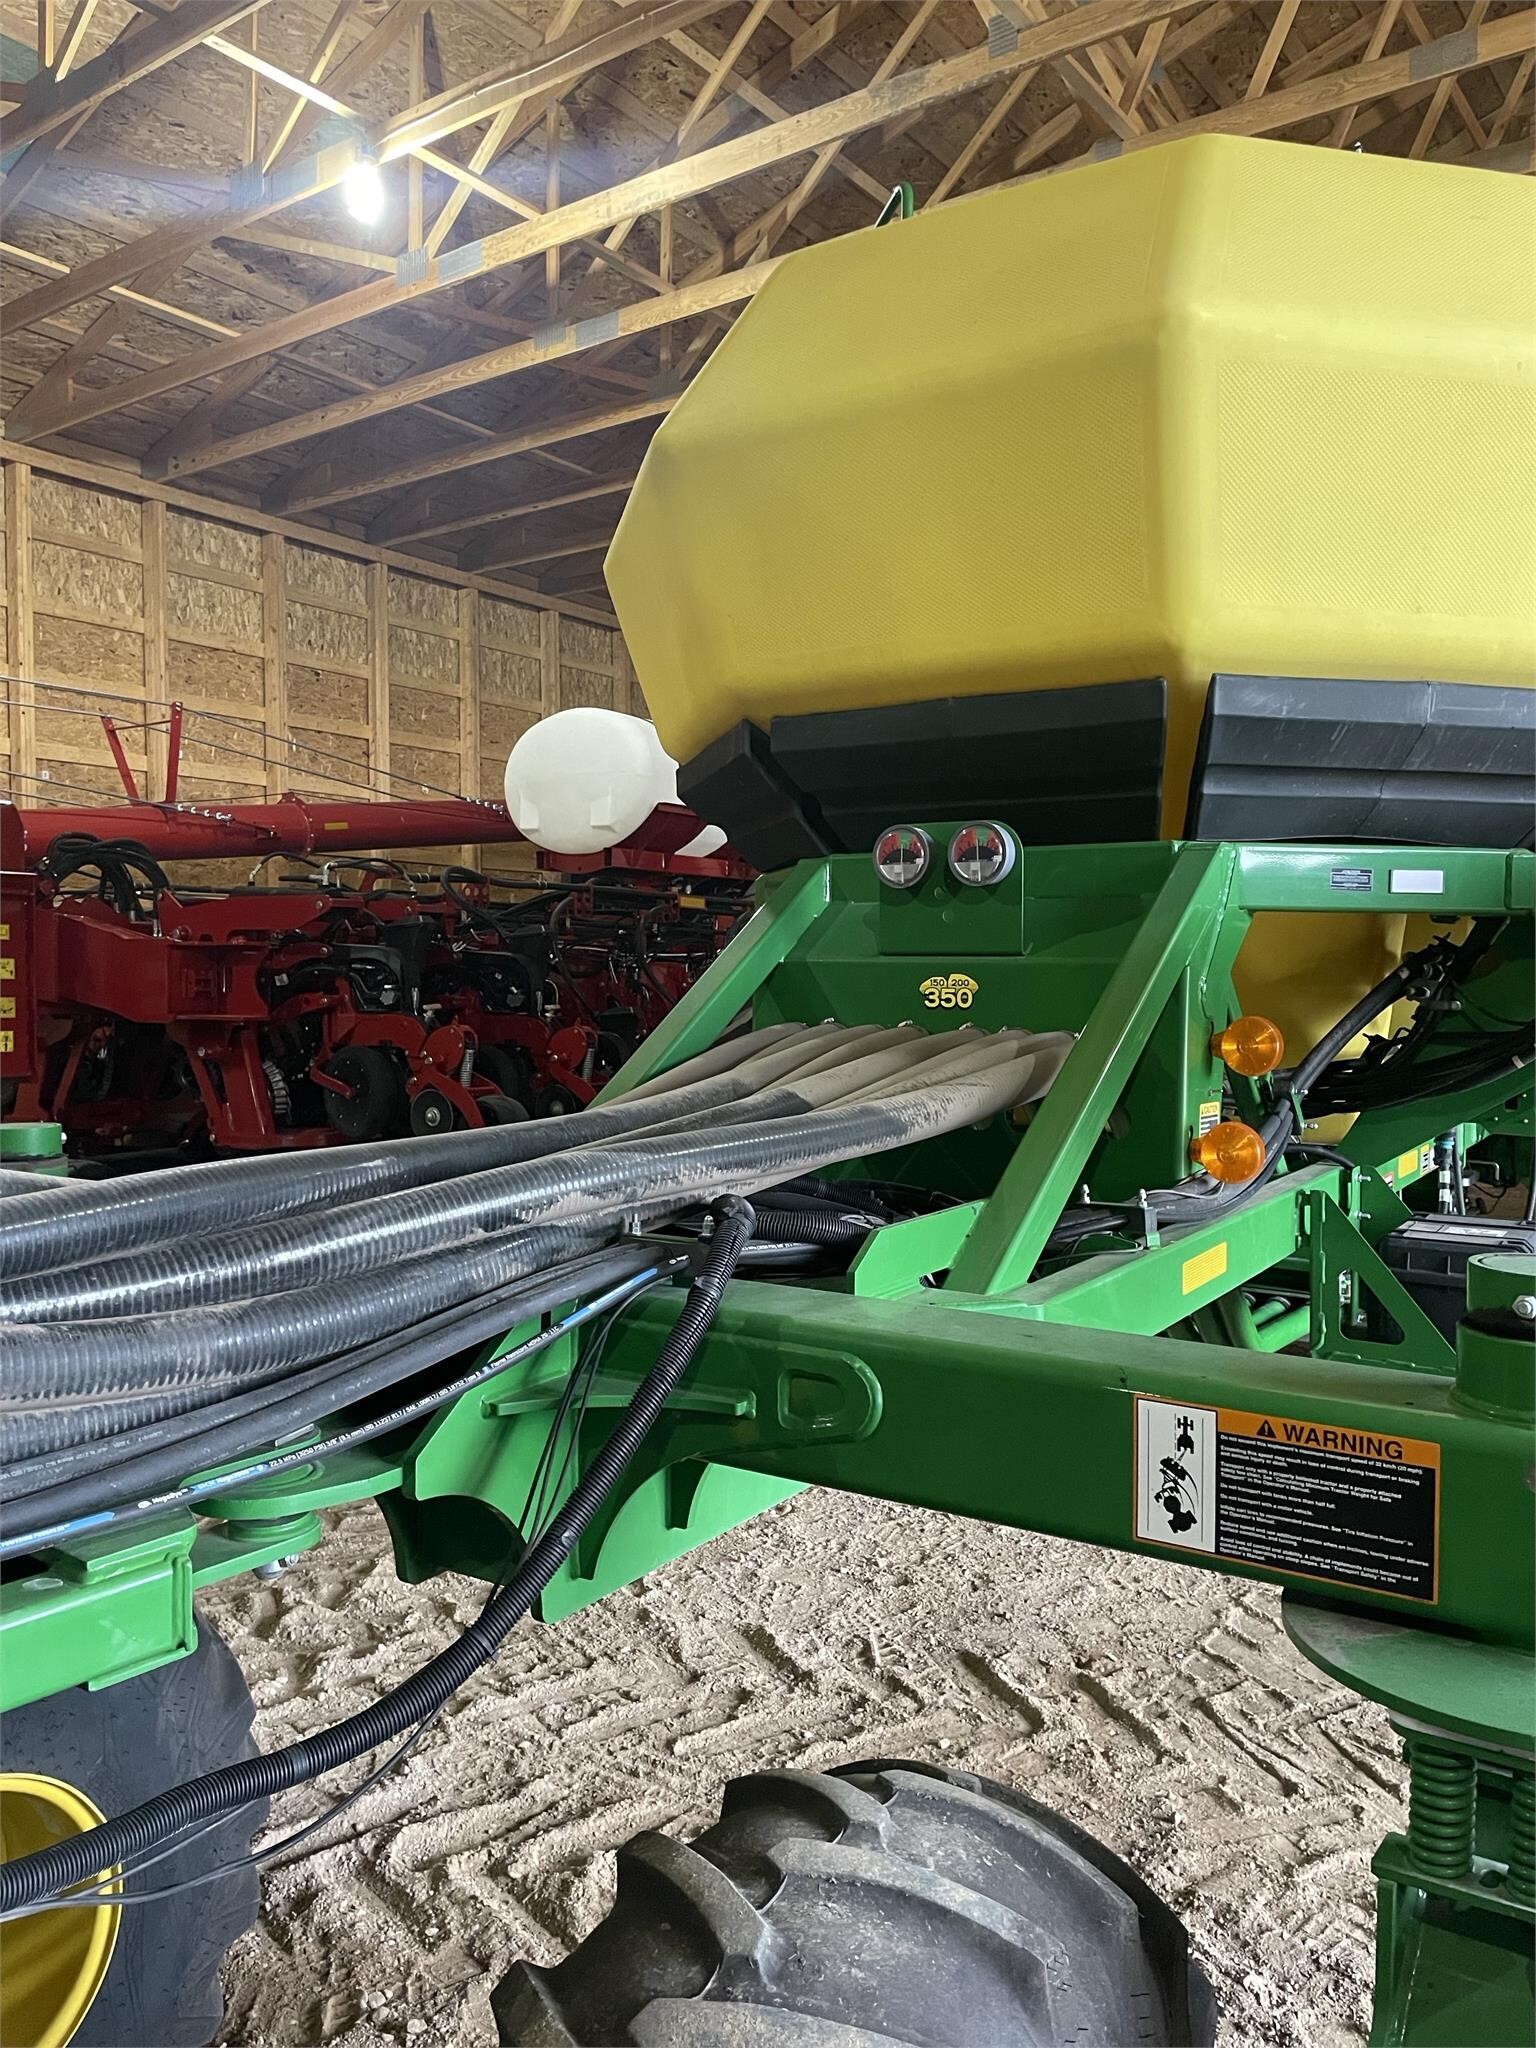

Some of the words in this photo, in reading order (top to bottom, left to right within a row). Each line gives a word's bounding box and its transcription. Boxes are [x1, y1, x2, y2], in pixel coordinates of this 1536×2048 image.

[930, 979, 945, 987] 150
[951, 979, 970, 987] 200
[924, 987, 973, 1008] 350
[1282, 1422, 1402, 1460] WARNING
